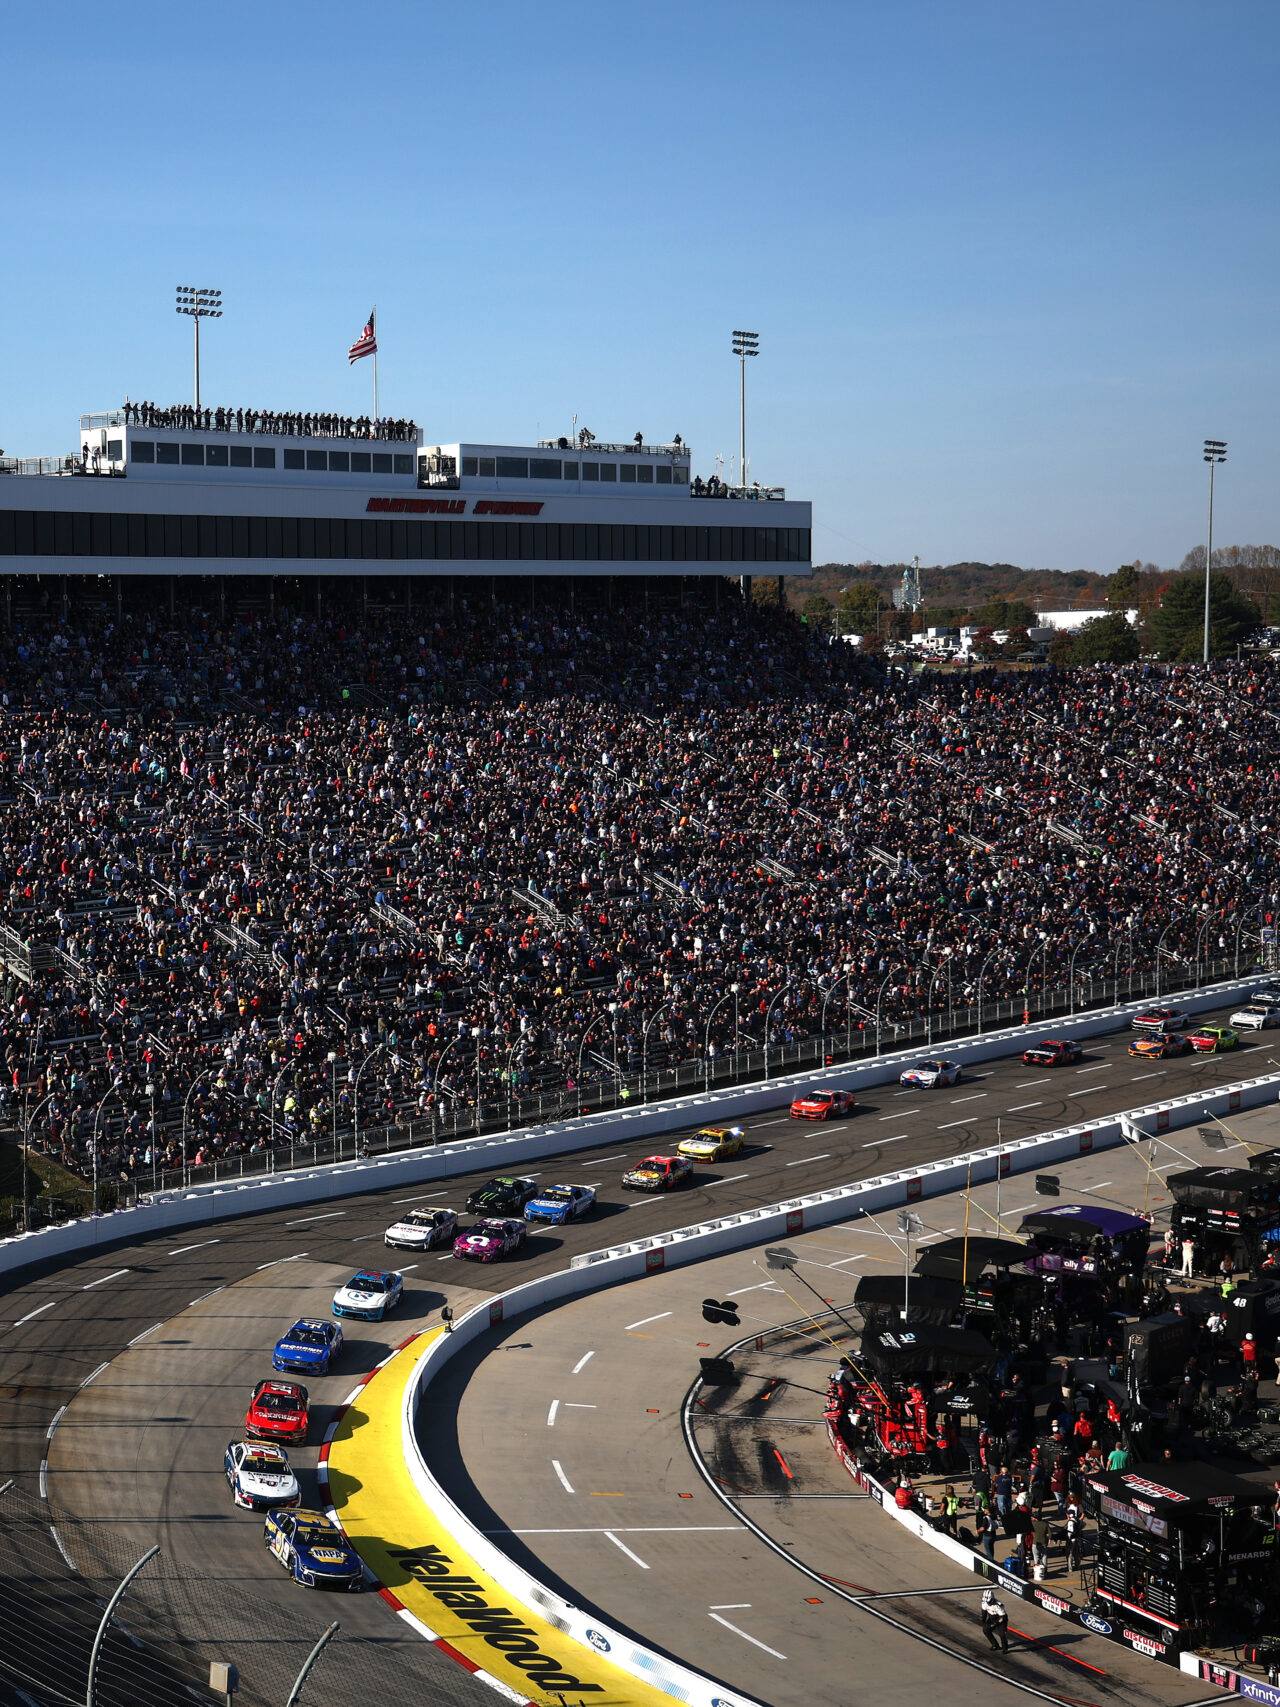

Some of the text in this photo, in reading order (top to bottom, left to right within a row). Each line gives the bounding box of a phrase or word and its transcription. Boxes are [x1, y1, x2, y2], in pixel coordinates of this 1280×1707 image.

[1063, 1260, 1095, 1272] ally 48
[1232, 1297, 1247, 1308] 48
[1122, 1474, 1189, 1502] DISCOUNT
[1130, 1483, 1159, 1498] TIRE
[1145, 1514, 1165, 1534] 12
[1262, 1534, 1275, 1545] 12
[314, 1550, 342, 1559] NAPA
[1228, 1550, 1271, 1561] MENARDS
[1034, 1589, 1071, 1612] DISCOUNT
[1044, 1601, 1059, 1612] TIRE
[385, 1544, 606, 1693] YellaWood
[1085, 1614, 1106, 1632] Ford
[589, 1631, 607, 1650] Ford
[1123, 1629, 1166, 1655] DISCOUNT
[1135, 1642, 1153, 1654] TIRE
[1243, 1683, 1280, 1706] xfinity
